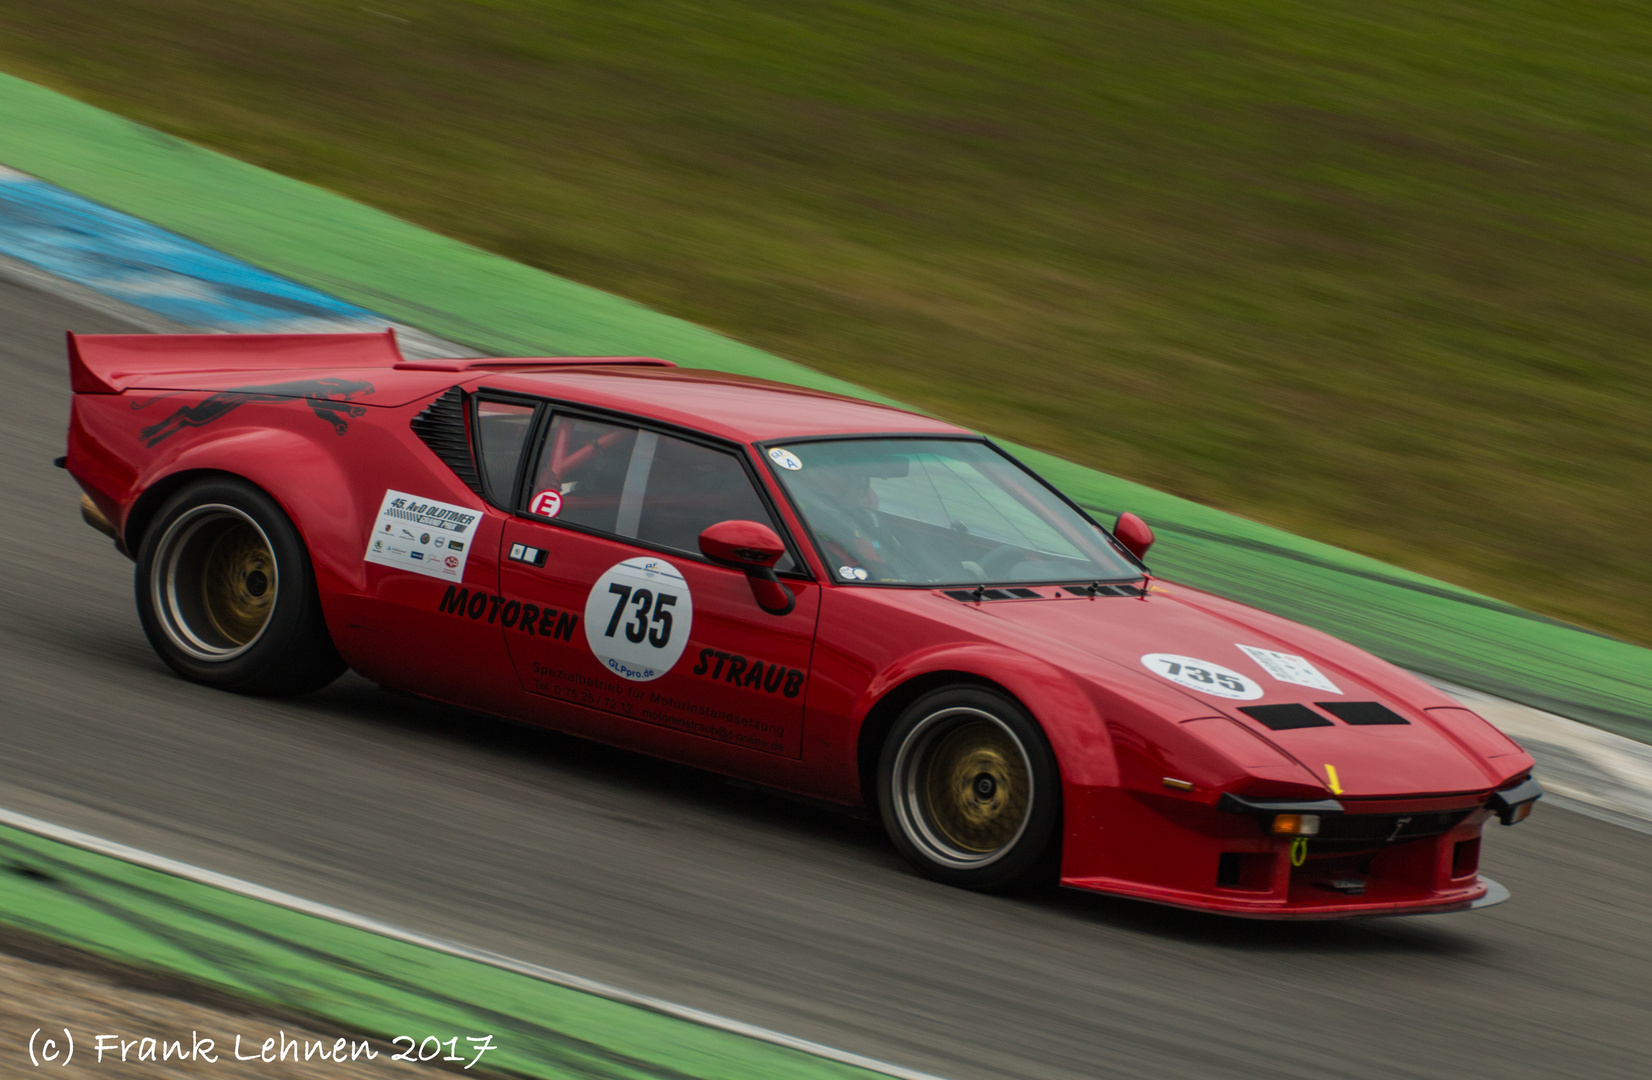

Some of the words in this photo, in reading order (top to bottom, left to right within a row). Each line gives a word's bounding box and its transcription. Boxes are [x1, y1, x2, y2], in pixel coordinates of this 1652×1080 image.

[786, 458, 798, 469] A
[391, 498, 407, 510] 45.
[406, 502, 428, 514] AvD
[425, 506, 475, 526] OLDTIMER
[535, 494, 557, 517] E
[439, 585, 578, 642] MOTOREN
[604, 582, 678, 649] 735
[608, 659, 654, 678] GLPpro.de
[693, 648, 805, 697] STRAUB
[1159, 659, 1246, 692] 735
[532, 661, 623, 694] Spezialbetrieb
[627, 686, 645, 700] für
[649, 691, 785, 738] Motorinstandsetzung
[604, 697, 617, 709] 72
